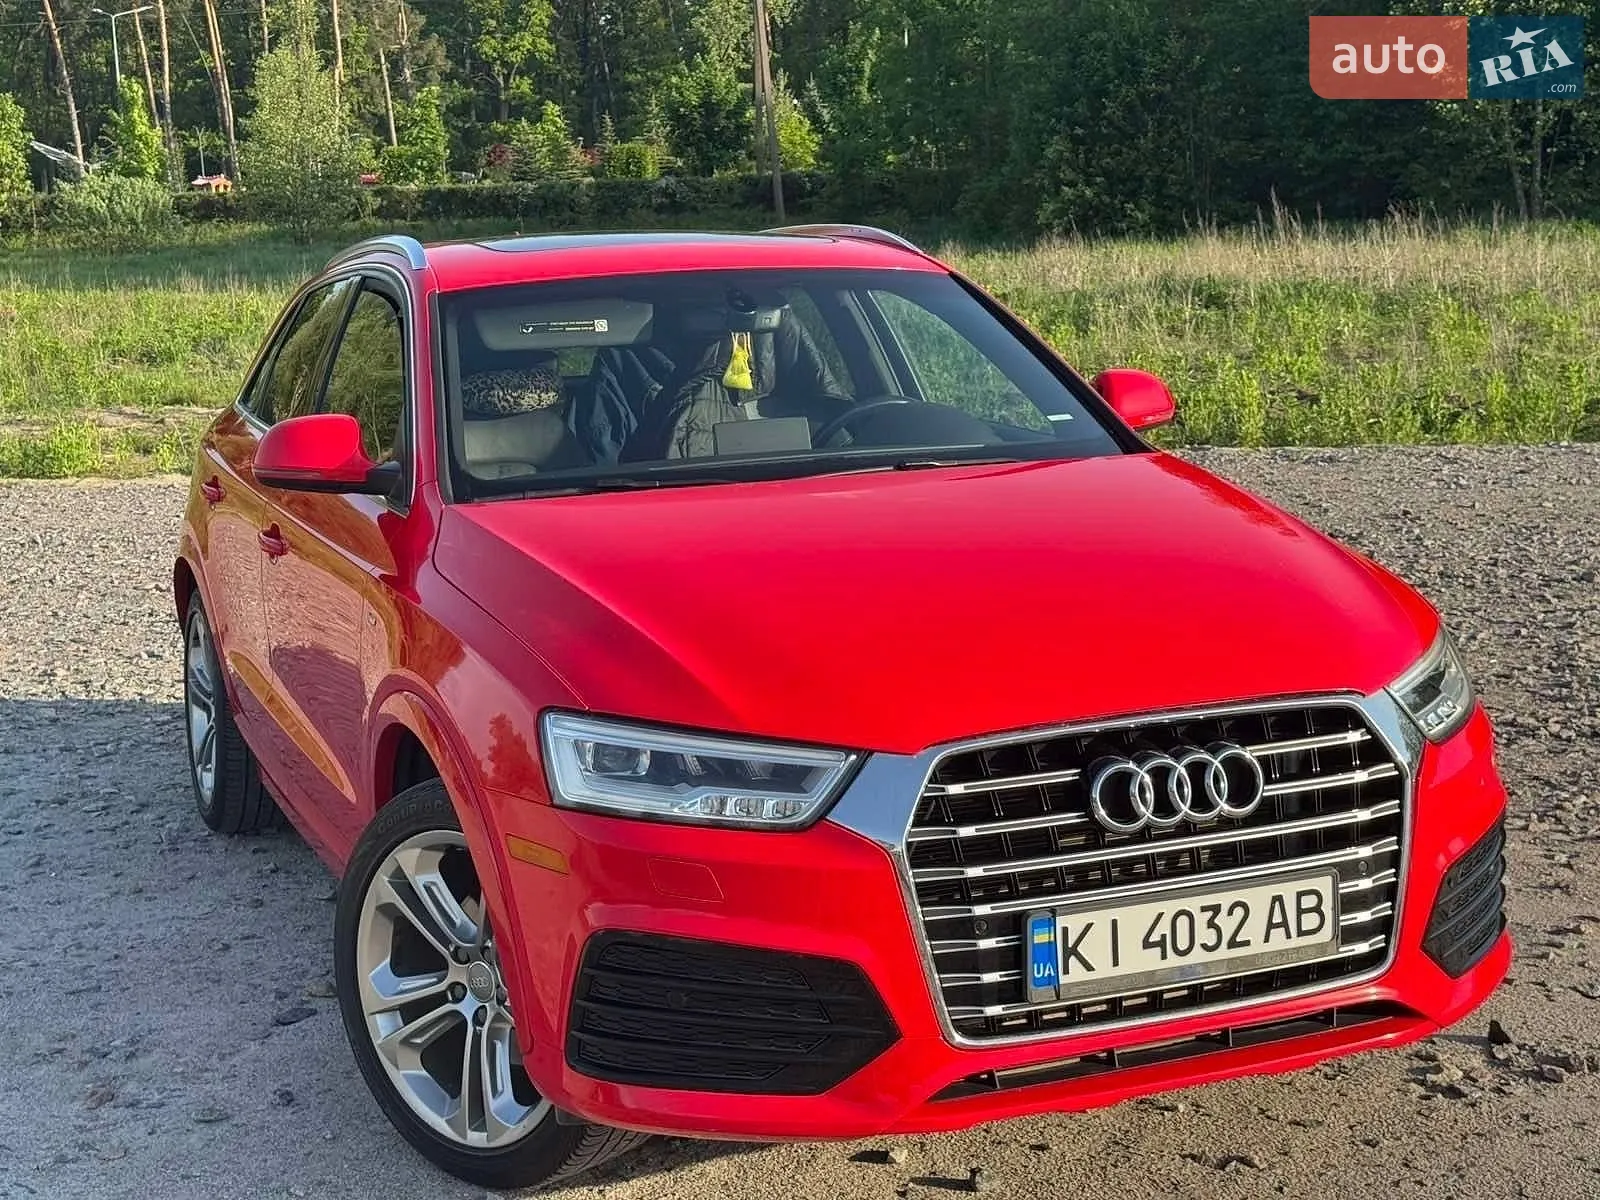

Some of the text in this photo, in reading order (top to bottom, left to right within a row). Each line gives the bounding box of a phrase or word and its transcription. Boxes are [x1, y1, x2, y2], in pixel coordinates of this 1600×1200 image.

[1061, 888, 1326, 976] KI 4032 AB
[1033, 961, 1055, 978] UA
